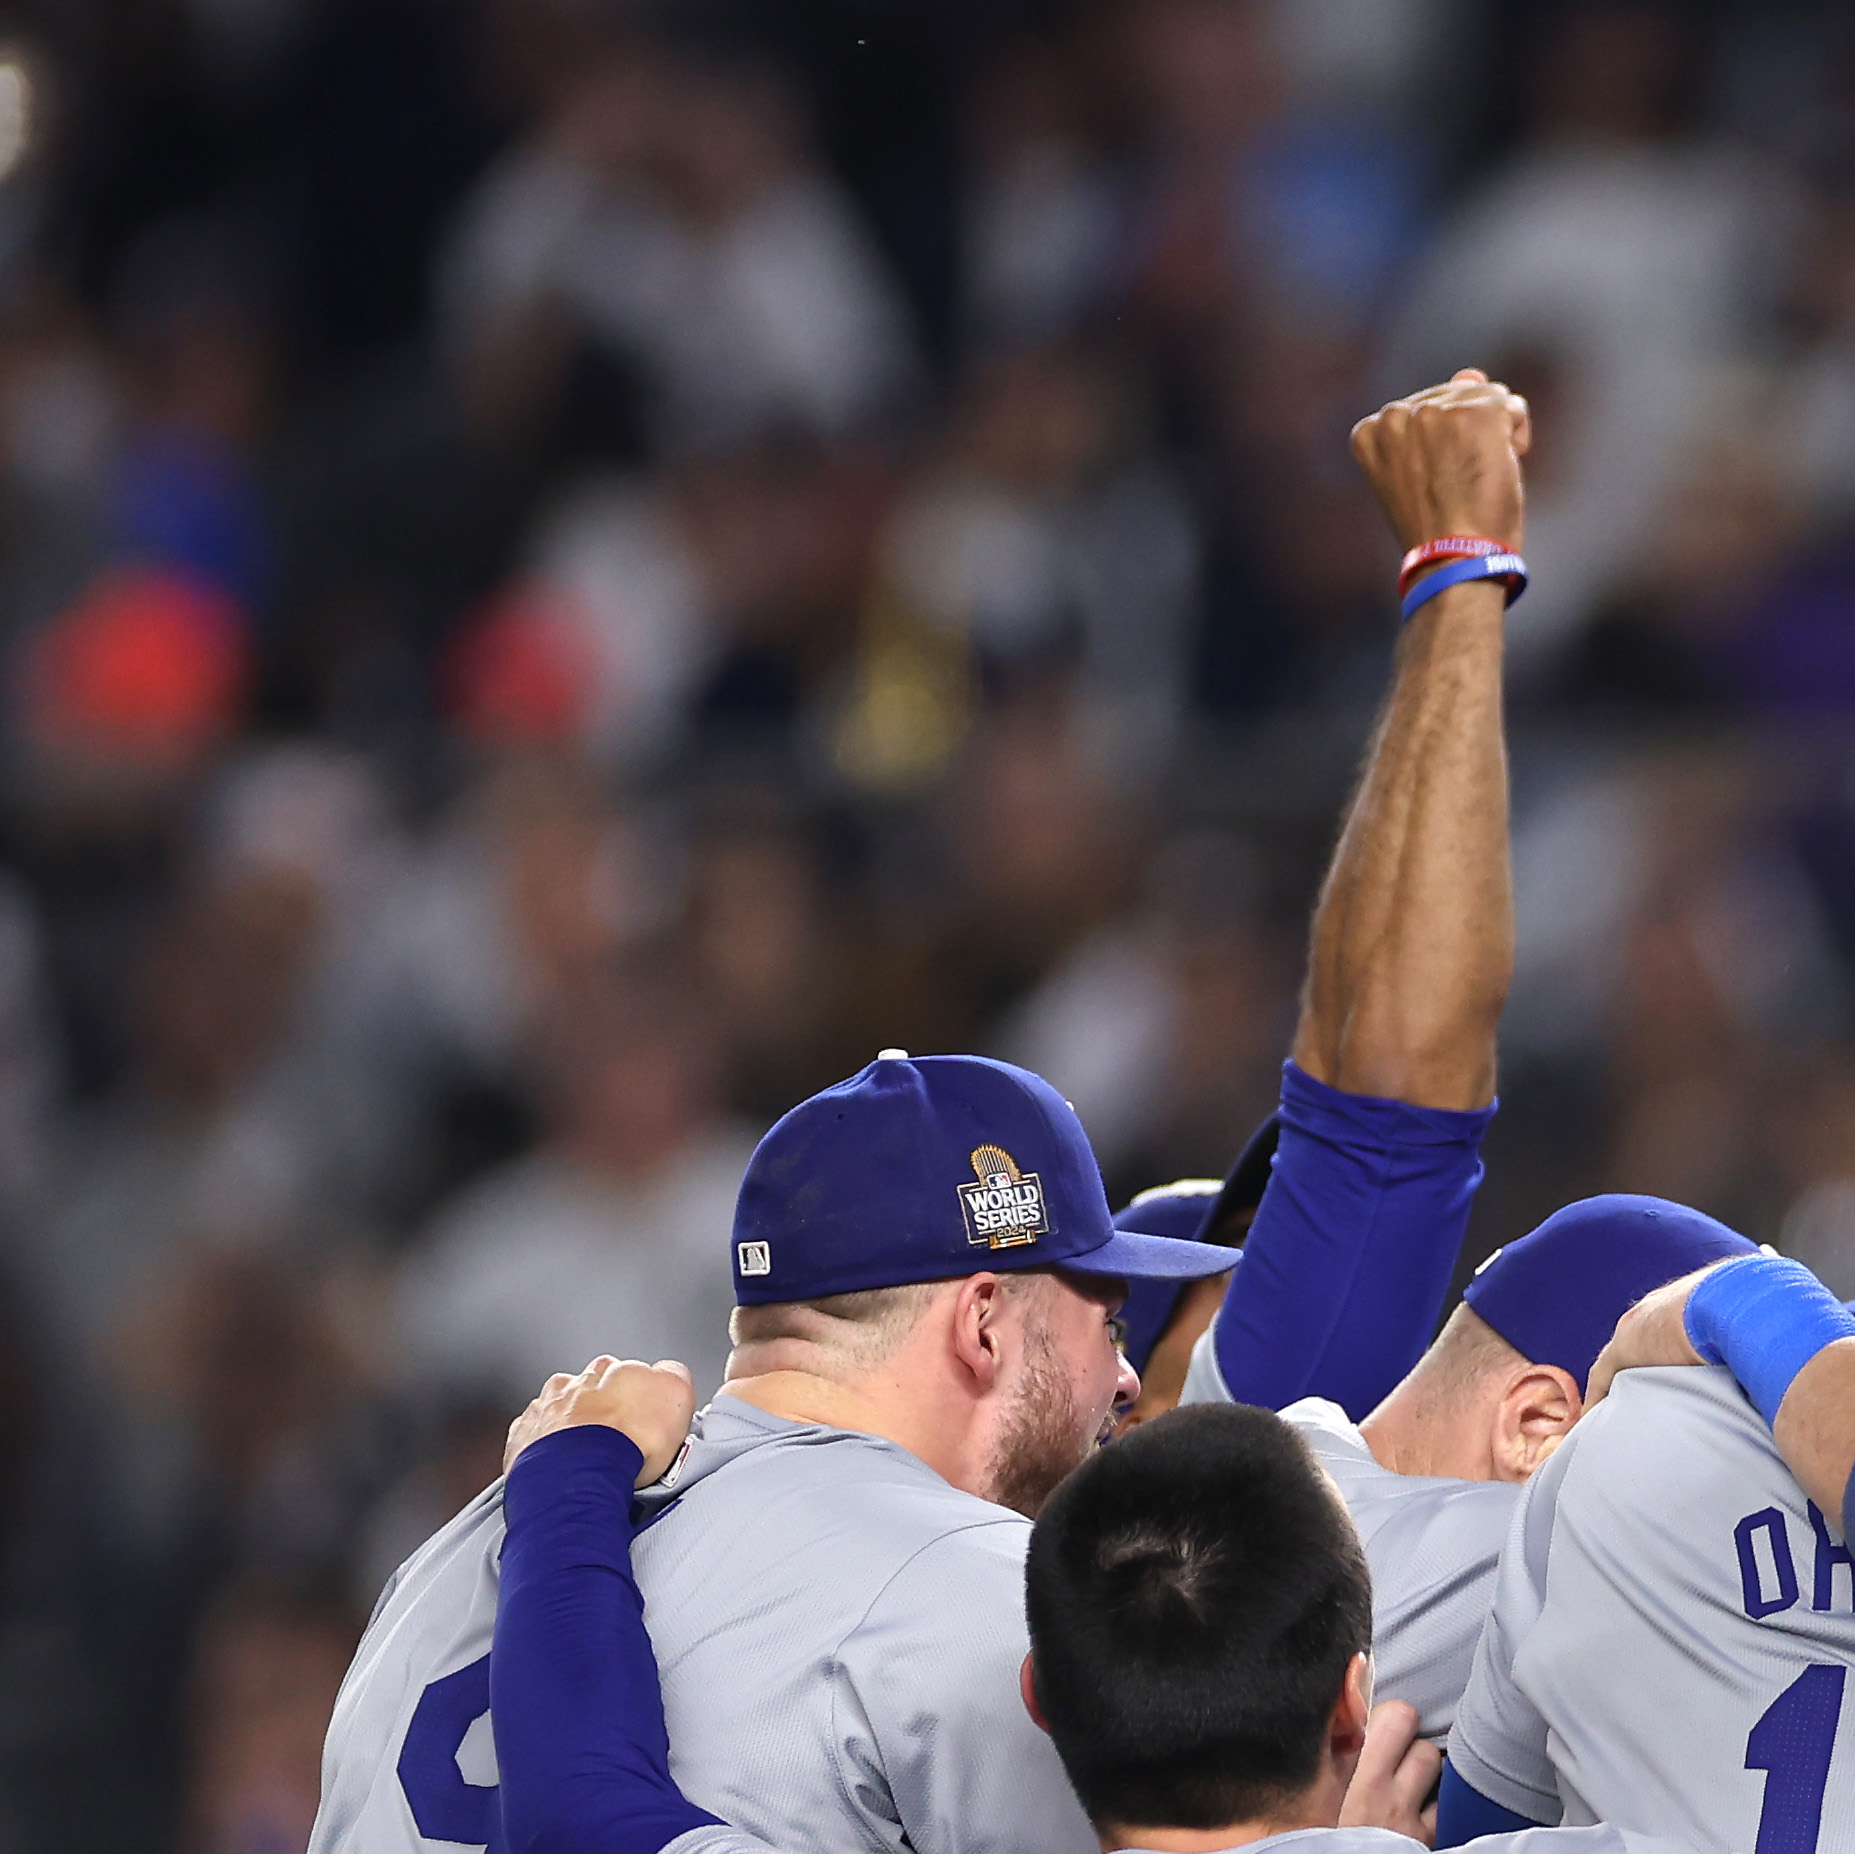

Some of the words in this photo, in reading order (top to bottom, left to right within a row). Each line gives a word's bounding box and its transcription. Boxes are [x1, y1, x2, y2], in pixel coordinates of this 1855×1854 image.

[964, 1185, 1039, 1213] WORLD
[973, 1203, 1041, 1231] SERIES
[996, 1226, 1026, 1238] 2024
